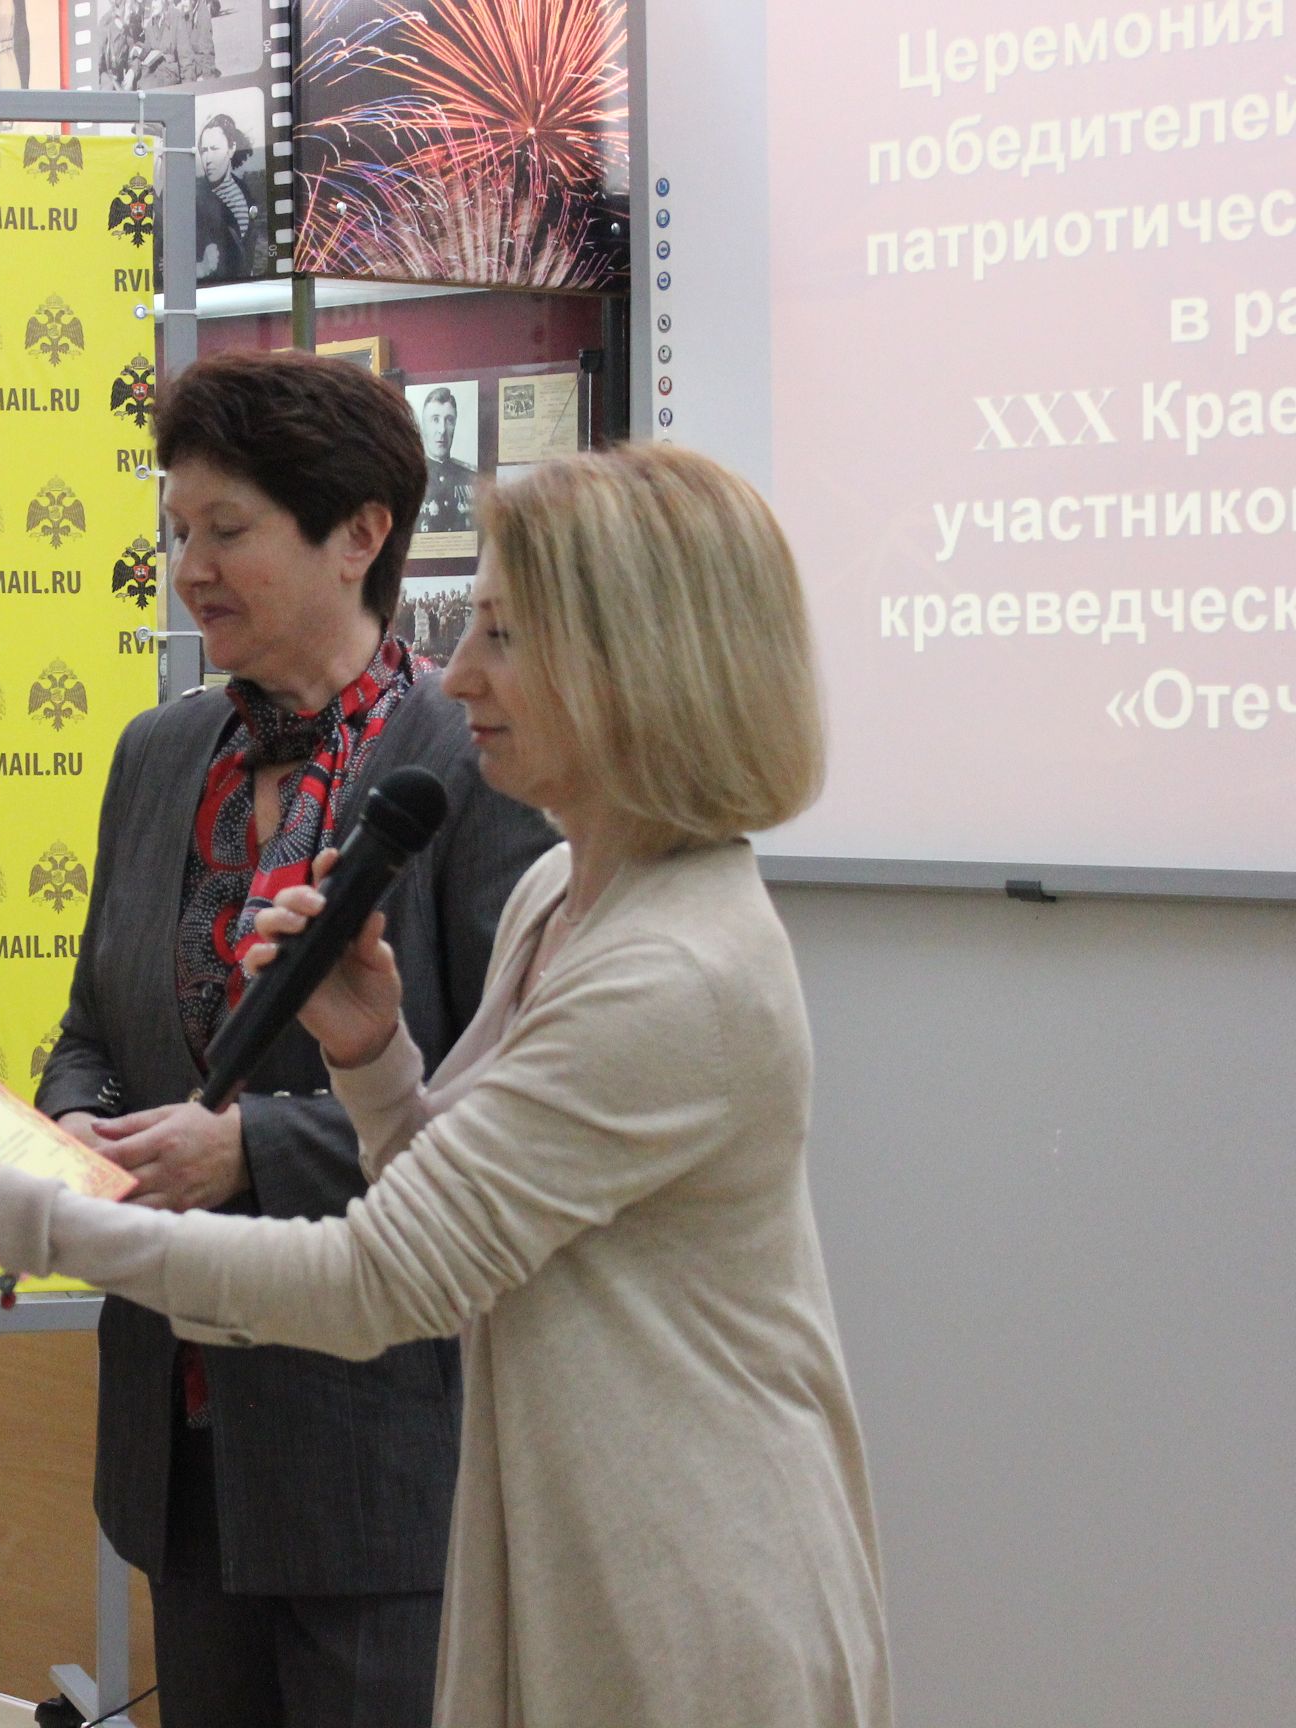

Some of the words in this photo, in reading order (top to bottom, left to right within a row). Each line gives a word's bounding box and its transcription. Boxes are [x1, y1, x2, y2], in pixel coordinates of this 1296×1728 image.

[897, 0, 1285, 97] Церемония
[866, 189, 1296, 280] патриотичес
[1170, 297, 1210, 344] в
[933, 486, 1296, 562] участнико
